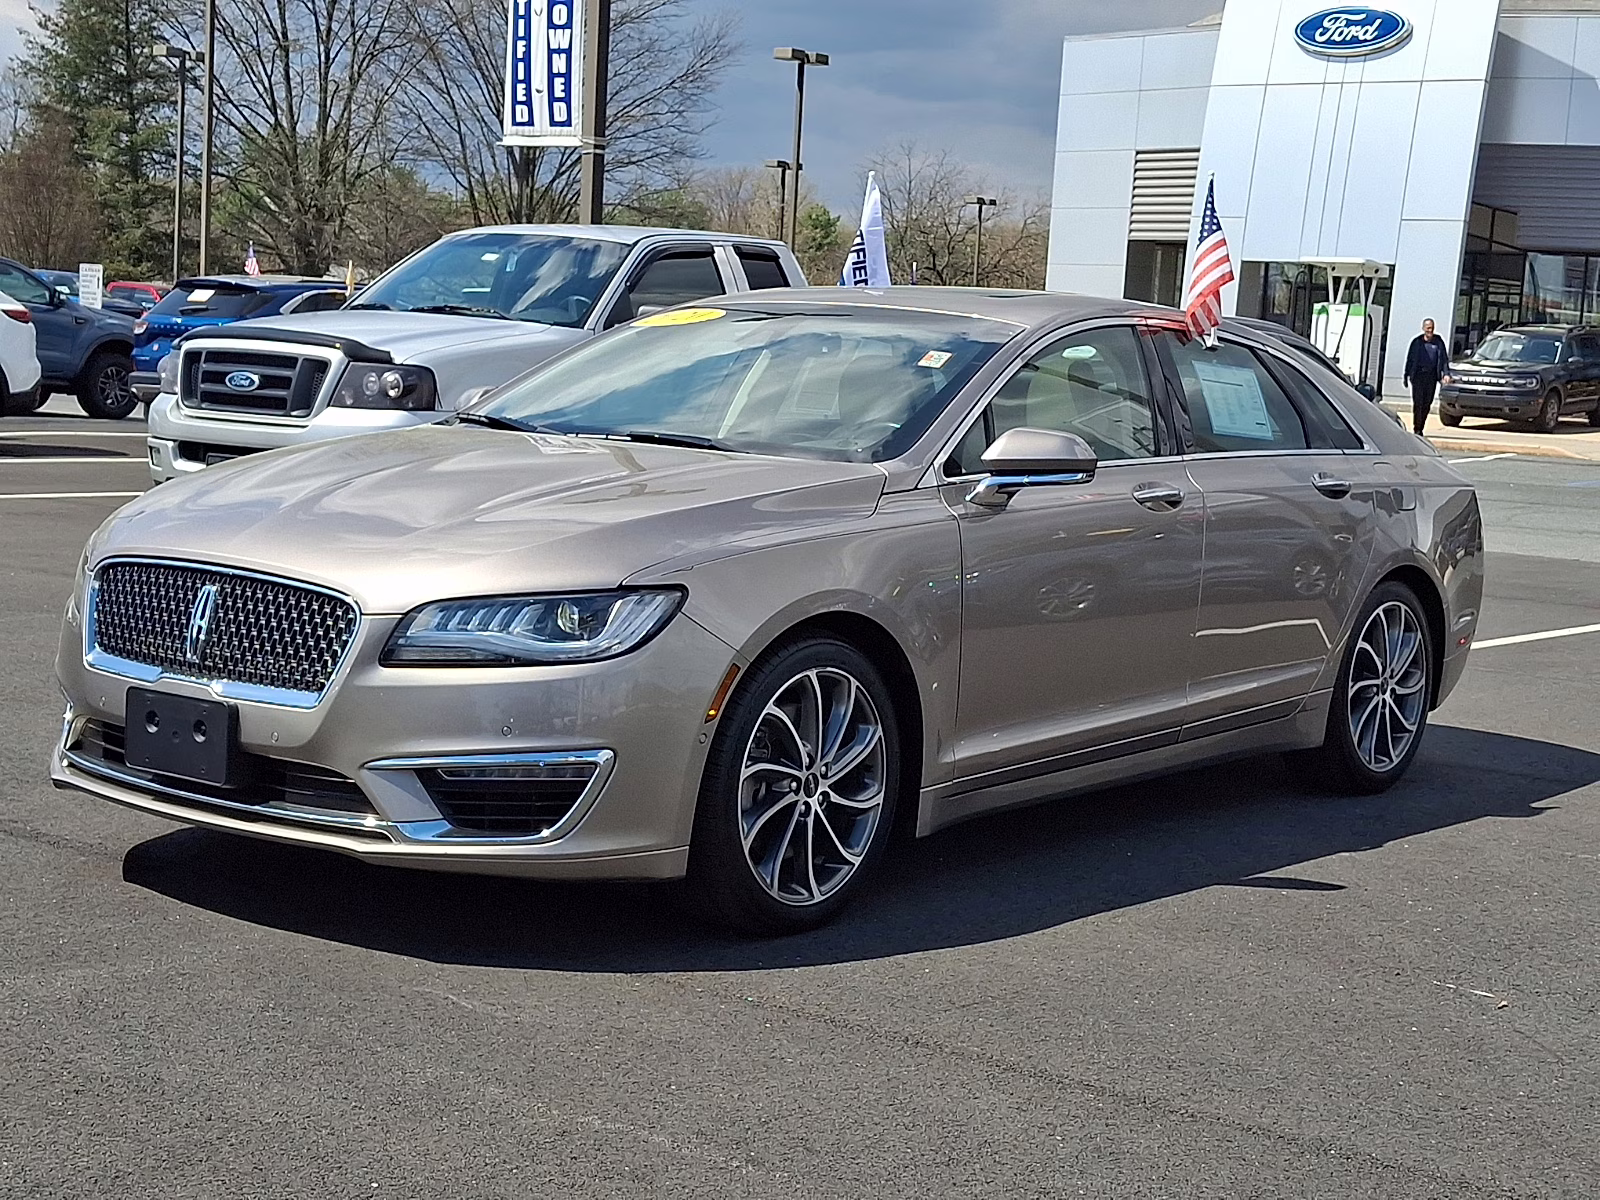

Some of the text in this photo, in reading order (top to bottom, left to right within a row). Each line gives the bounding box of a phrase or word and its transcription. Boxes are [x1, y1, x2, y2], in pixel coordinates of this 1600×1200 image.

[1314, 12, 1383, 43] Ford
[548, 3, 572, 122] OWNED
[231, 373, 251, 387] Ford
